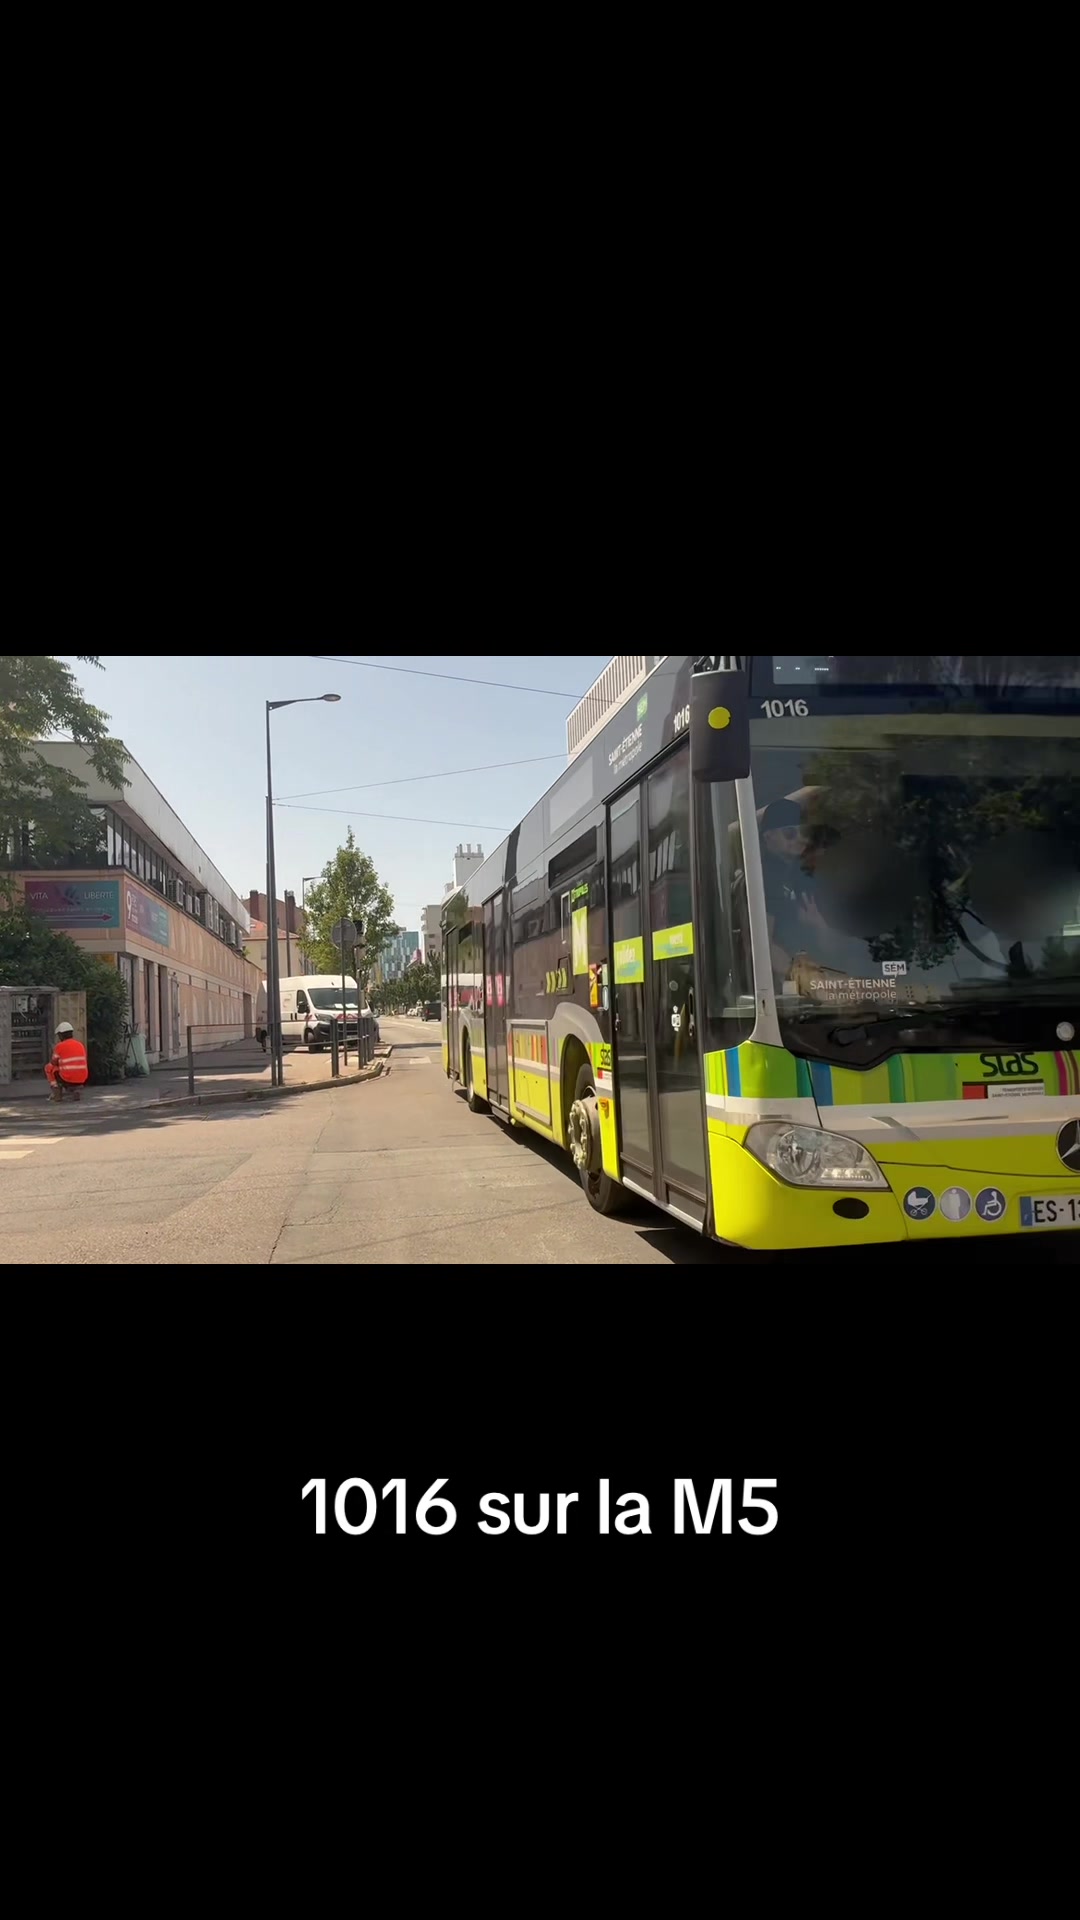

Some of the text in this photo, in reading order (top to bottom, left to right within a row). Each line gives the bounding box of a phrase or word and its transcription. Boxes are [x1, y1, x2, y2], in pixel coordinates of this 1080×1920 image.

[761, 699, 809, 719] 1016
[674, 704, 690, 734] 1016
[29, 891, 49, 900] VITA
[809, 977, 897, 990] SAINT-ÉTIENNE
[838, 988, 897, 1003] métropole
[1034, 1198, 1080, 1223] ES-1
